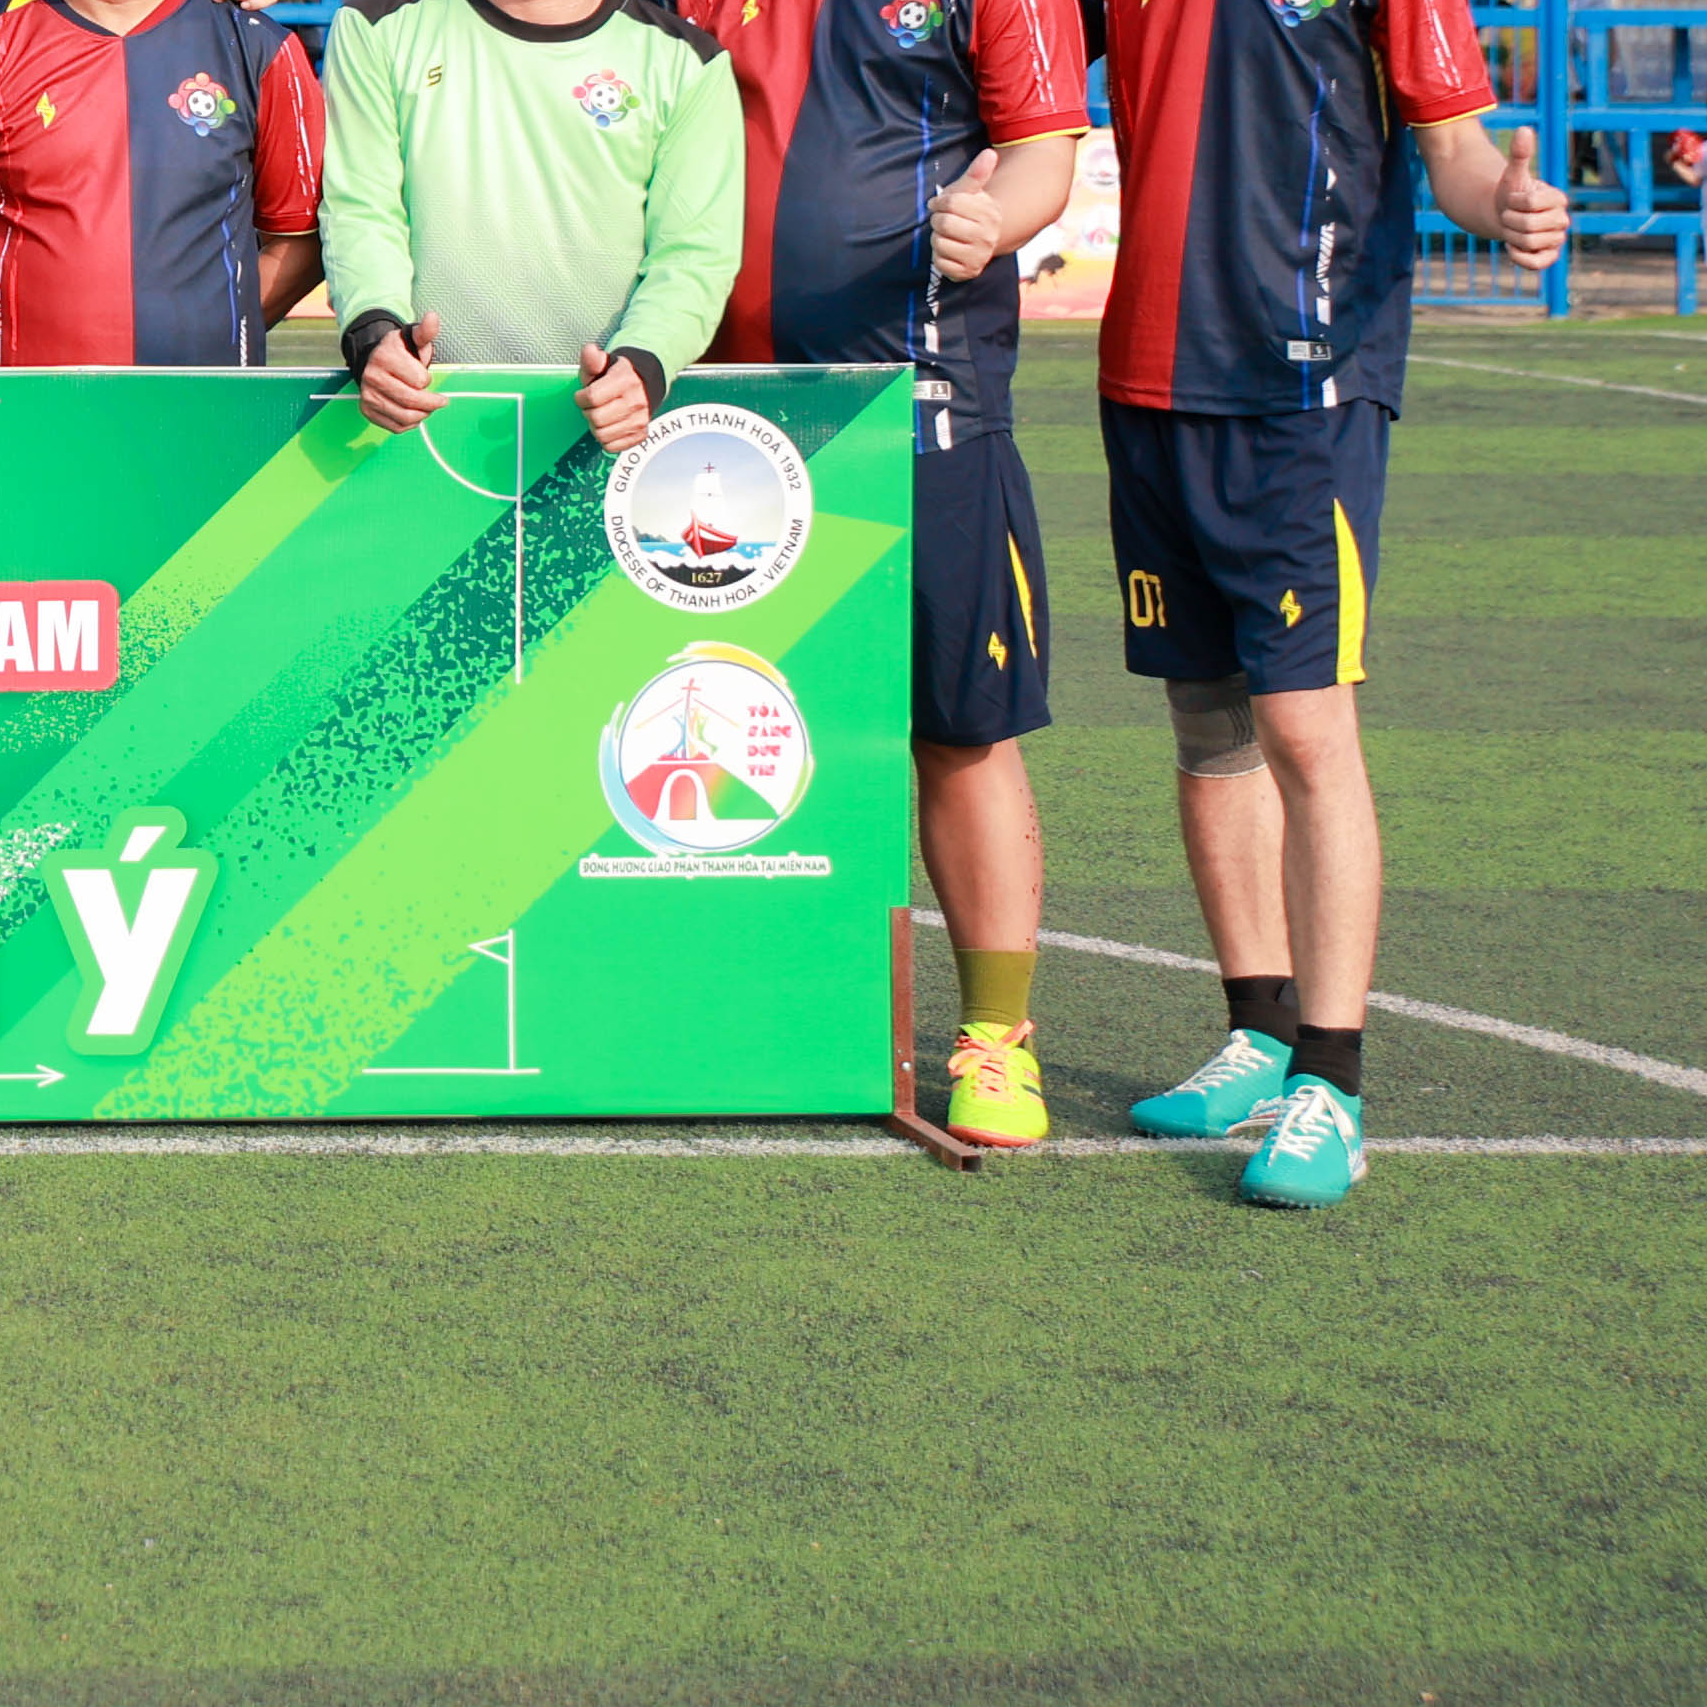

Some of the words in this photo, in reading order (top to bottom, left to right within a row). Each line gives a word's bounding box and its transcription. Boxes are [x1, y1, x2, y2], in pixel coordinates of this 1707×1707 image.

[687, 412, 746, 430] THANH
[750, 423, 785, 455] HOÁ
[780, 455, 802, 491] 1932
[611, 515, 648, 581] DIOCESE
[646, 577, 667, 593] OF
[669, 588, 721, 608] THANH
[726, 585, 757, 603] HOA
[763, 518, 803, 582] VIETNAM
[691, 572, 722, 584] 1627
[62, 825, 199, 1035] Ý
